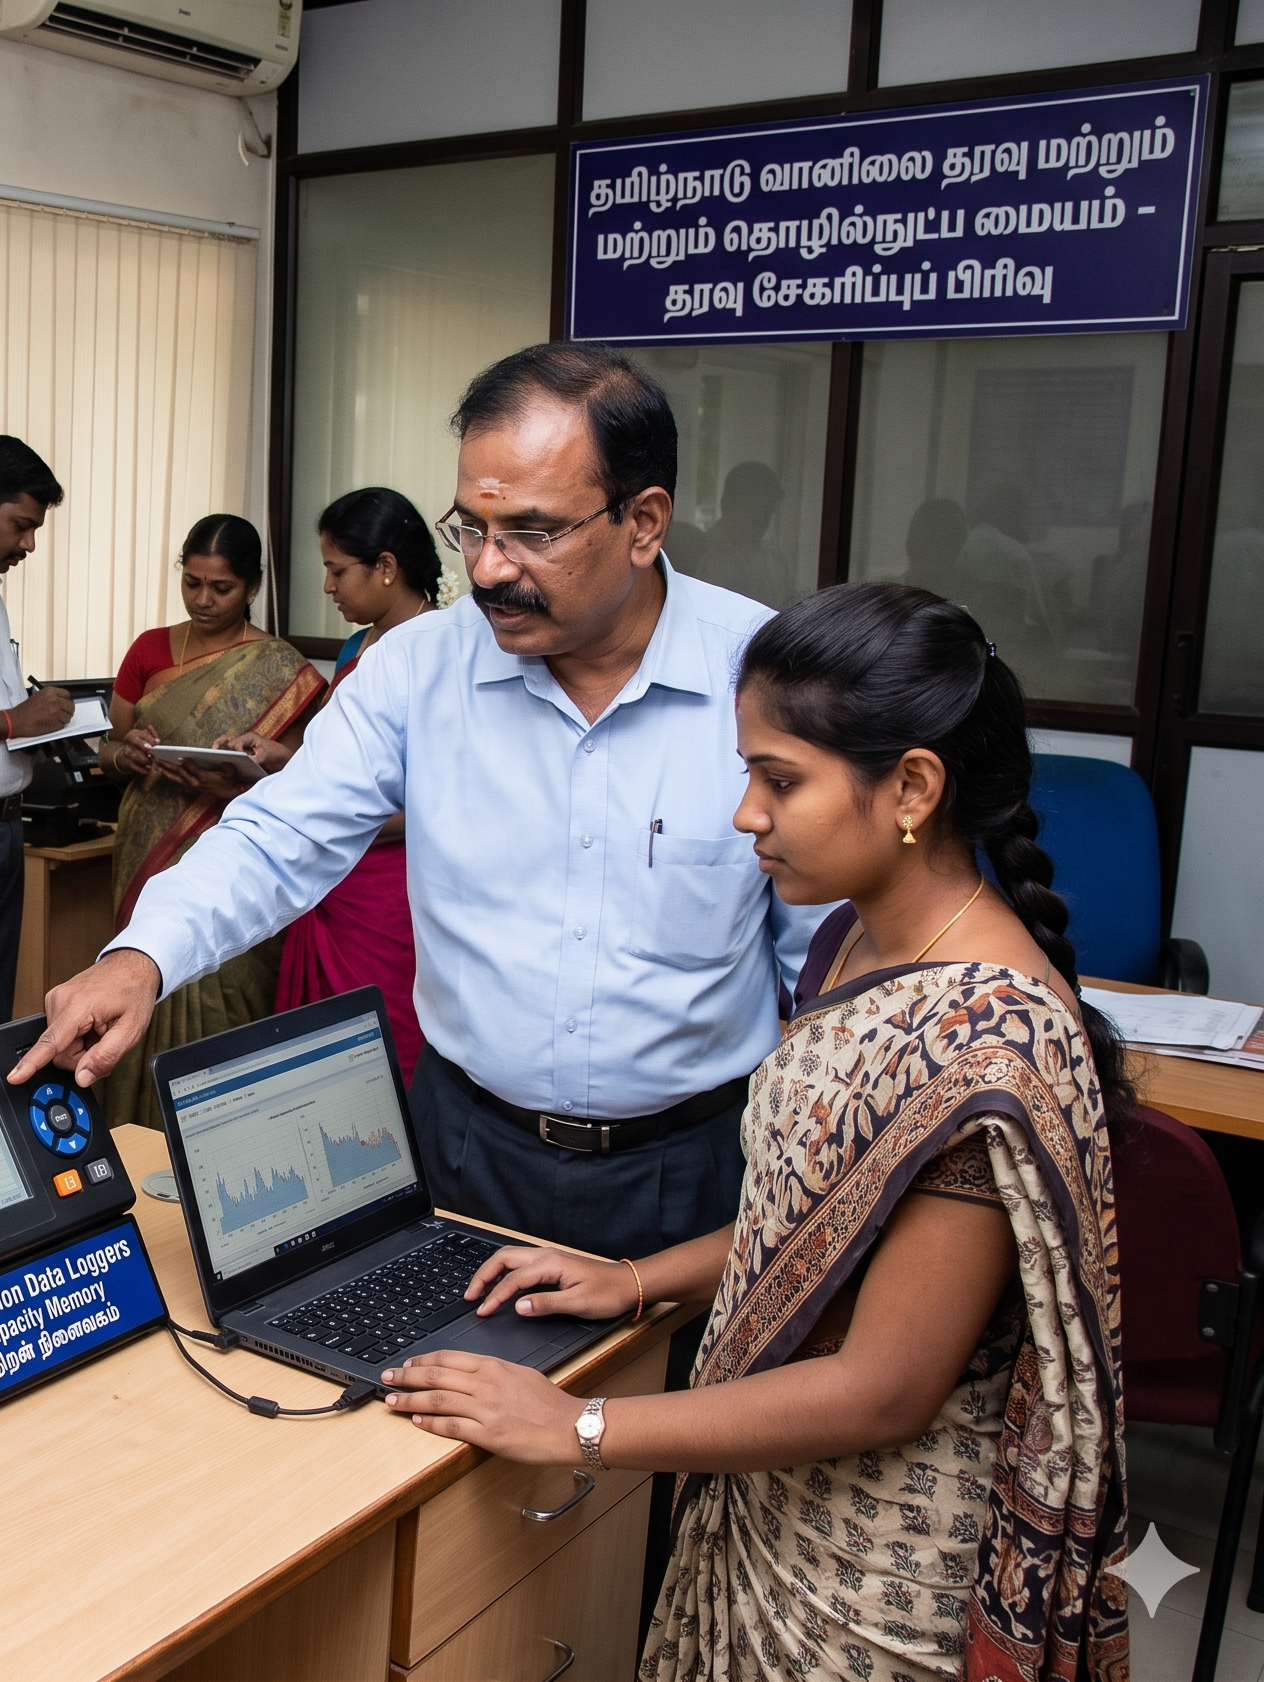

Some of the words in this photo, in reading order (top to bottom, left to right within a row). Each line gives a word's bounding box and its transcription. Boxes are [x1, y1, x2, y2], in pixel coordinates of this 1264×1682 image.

[588, 159, 751, 218] தமிழ்நாடு
[759, 146, 934, 192] வானிலை
[940, 141, 1029, 190] தரவு
[1037, 115, 1176, 178] மற்றும்
[596, 216, 716, 271] மற்றும்
[723, 204, 965, 262] தொழில்நுட்ப
[974, 185, 1126, 237] மையம்
[663, 281, 744, 323] தரவு
[752, 260, 938, 311] சேகரிப்புப்
[946, 257, 1054, 304] பிரிவு
[23, 1266, 66, 1298] Data
[64, 1239, 131, 1280] Loggers
[44, 1280, 106, 1320] Memory
